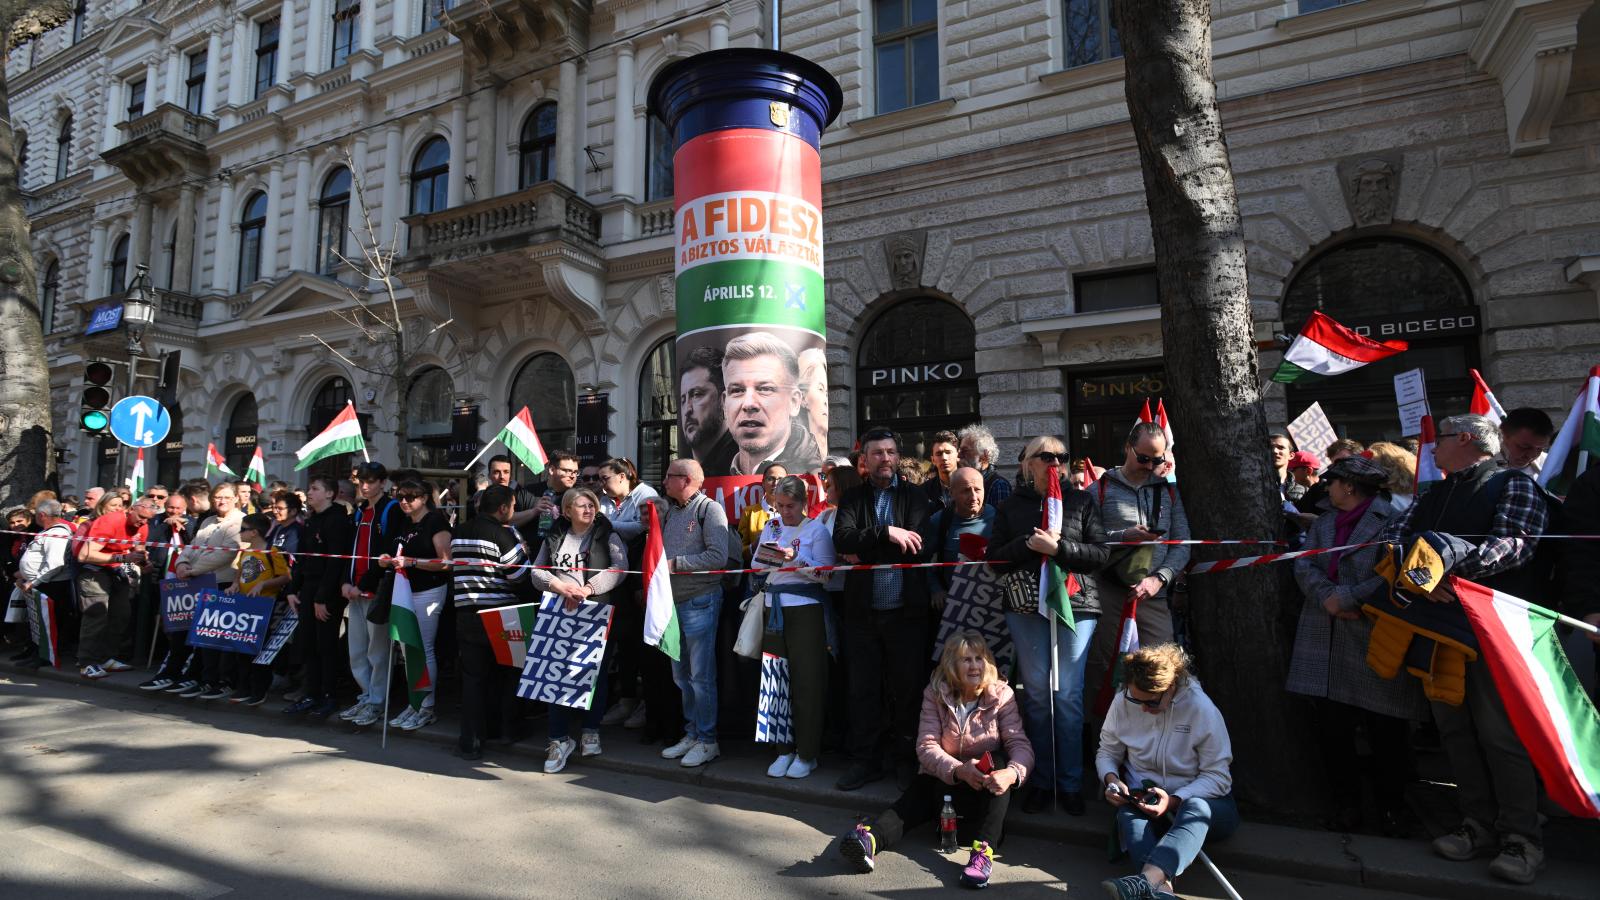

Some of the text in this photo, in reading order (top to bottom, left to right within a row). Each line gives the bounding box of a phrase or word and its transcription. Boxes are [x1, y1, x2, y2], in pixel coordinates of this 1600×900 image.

[681, 198, 820, 247] A FIDESZ
[681, 234, 820, 267] A BIZTOS VÁLASZTÁS
[703, 284, 777, 303] ÁPRILIS 12.
[1380, 315, 1475, 336] BICEGO
[872, 363, 962, 386] PINKO
[1083, 380, 1163, 398] PINKO
[235, 435, 256, 444] BOGGI
[576, 433, 607, 445] NUBU
[218, 596, 236, 604] TISZA
[197, 608, 264, 633] MOST
[534, 612, 608, 644] TISZA
[942, 597, 1009, 637] TISZ
[196, 626, 258, 643] VAGY SOHA!
[528, 634, 603, 667] TISZA
[522, 655, 598, 689] TISZA
[516, 677, 592, 711] TISZA
[755, 653, 772, 743] TISZA
[766, 656, 781, 743] TISZA
[776, 656, 791, 744] TISZA
